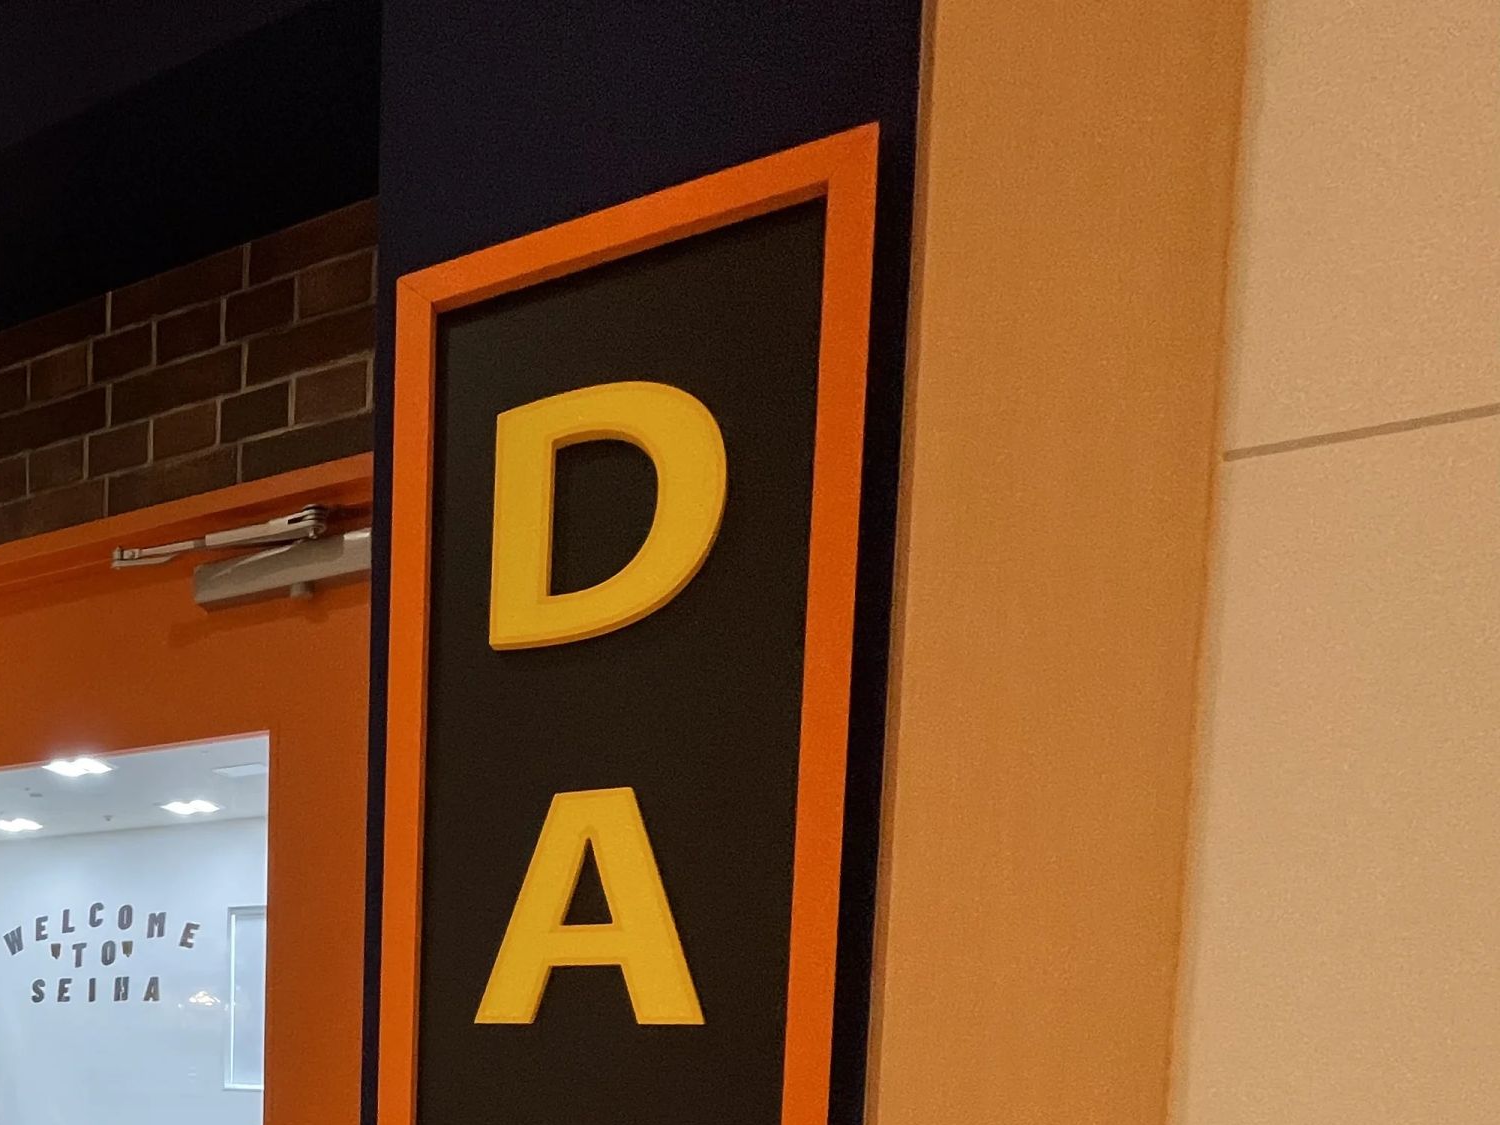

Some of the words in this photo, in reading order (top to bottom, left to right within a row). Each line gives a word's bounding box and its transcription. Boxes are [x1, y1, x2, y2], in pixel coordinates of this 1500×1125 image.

[2, 901, 201, 957] WELCOME
[72, 940, 116, 969] TO
[30, 976, 161, 1004] SEIHA
